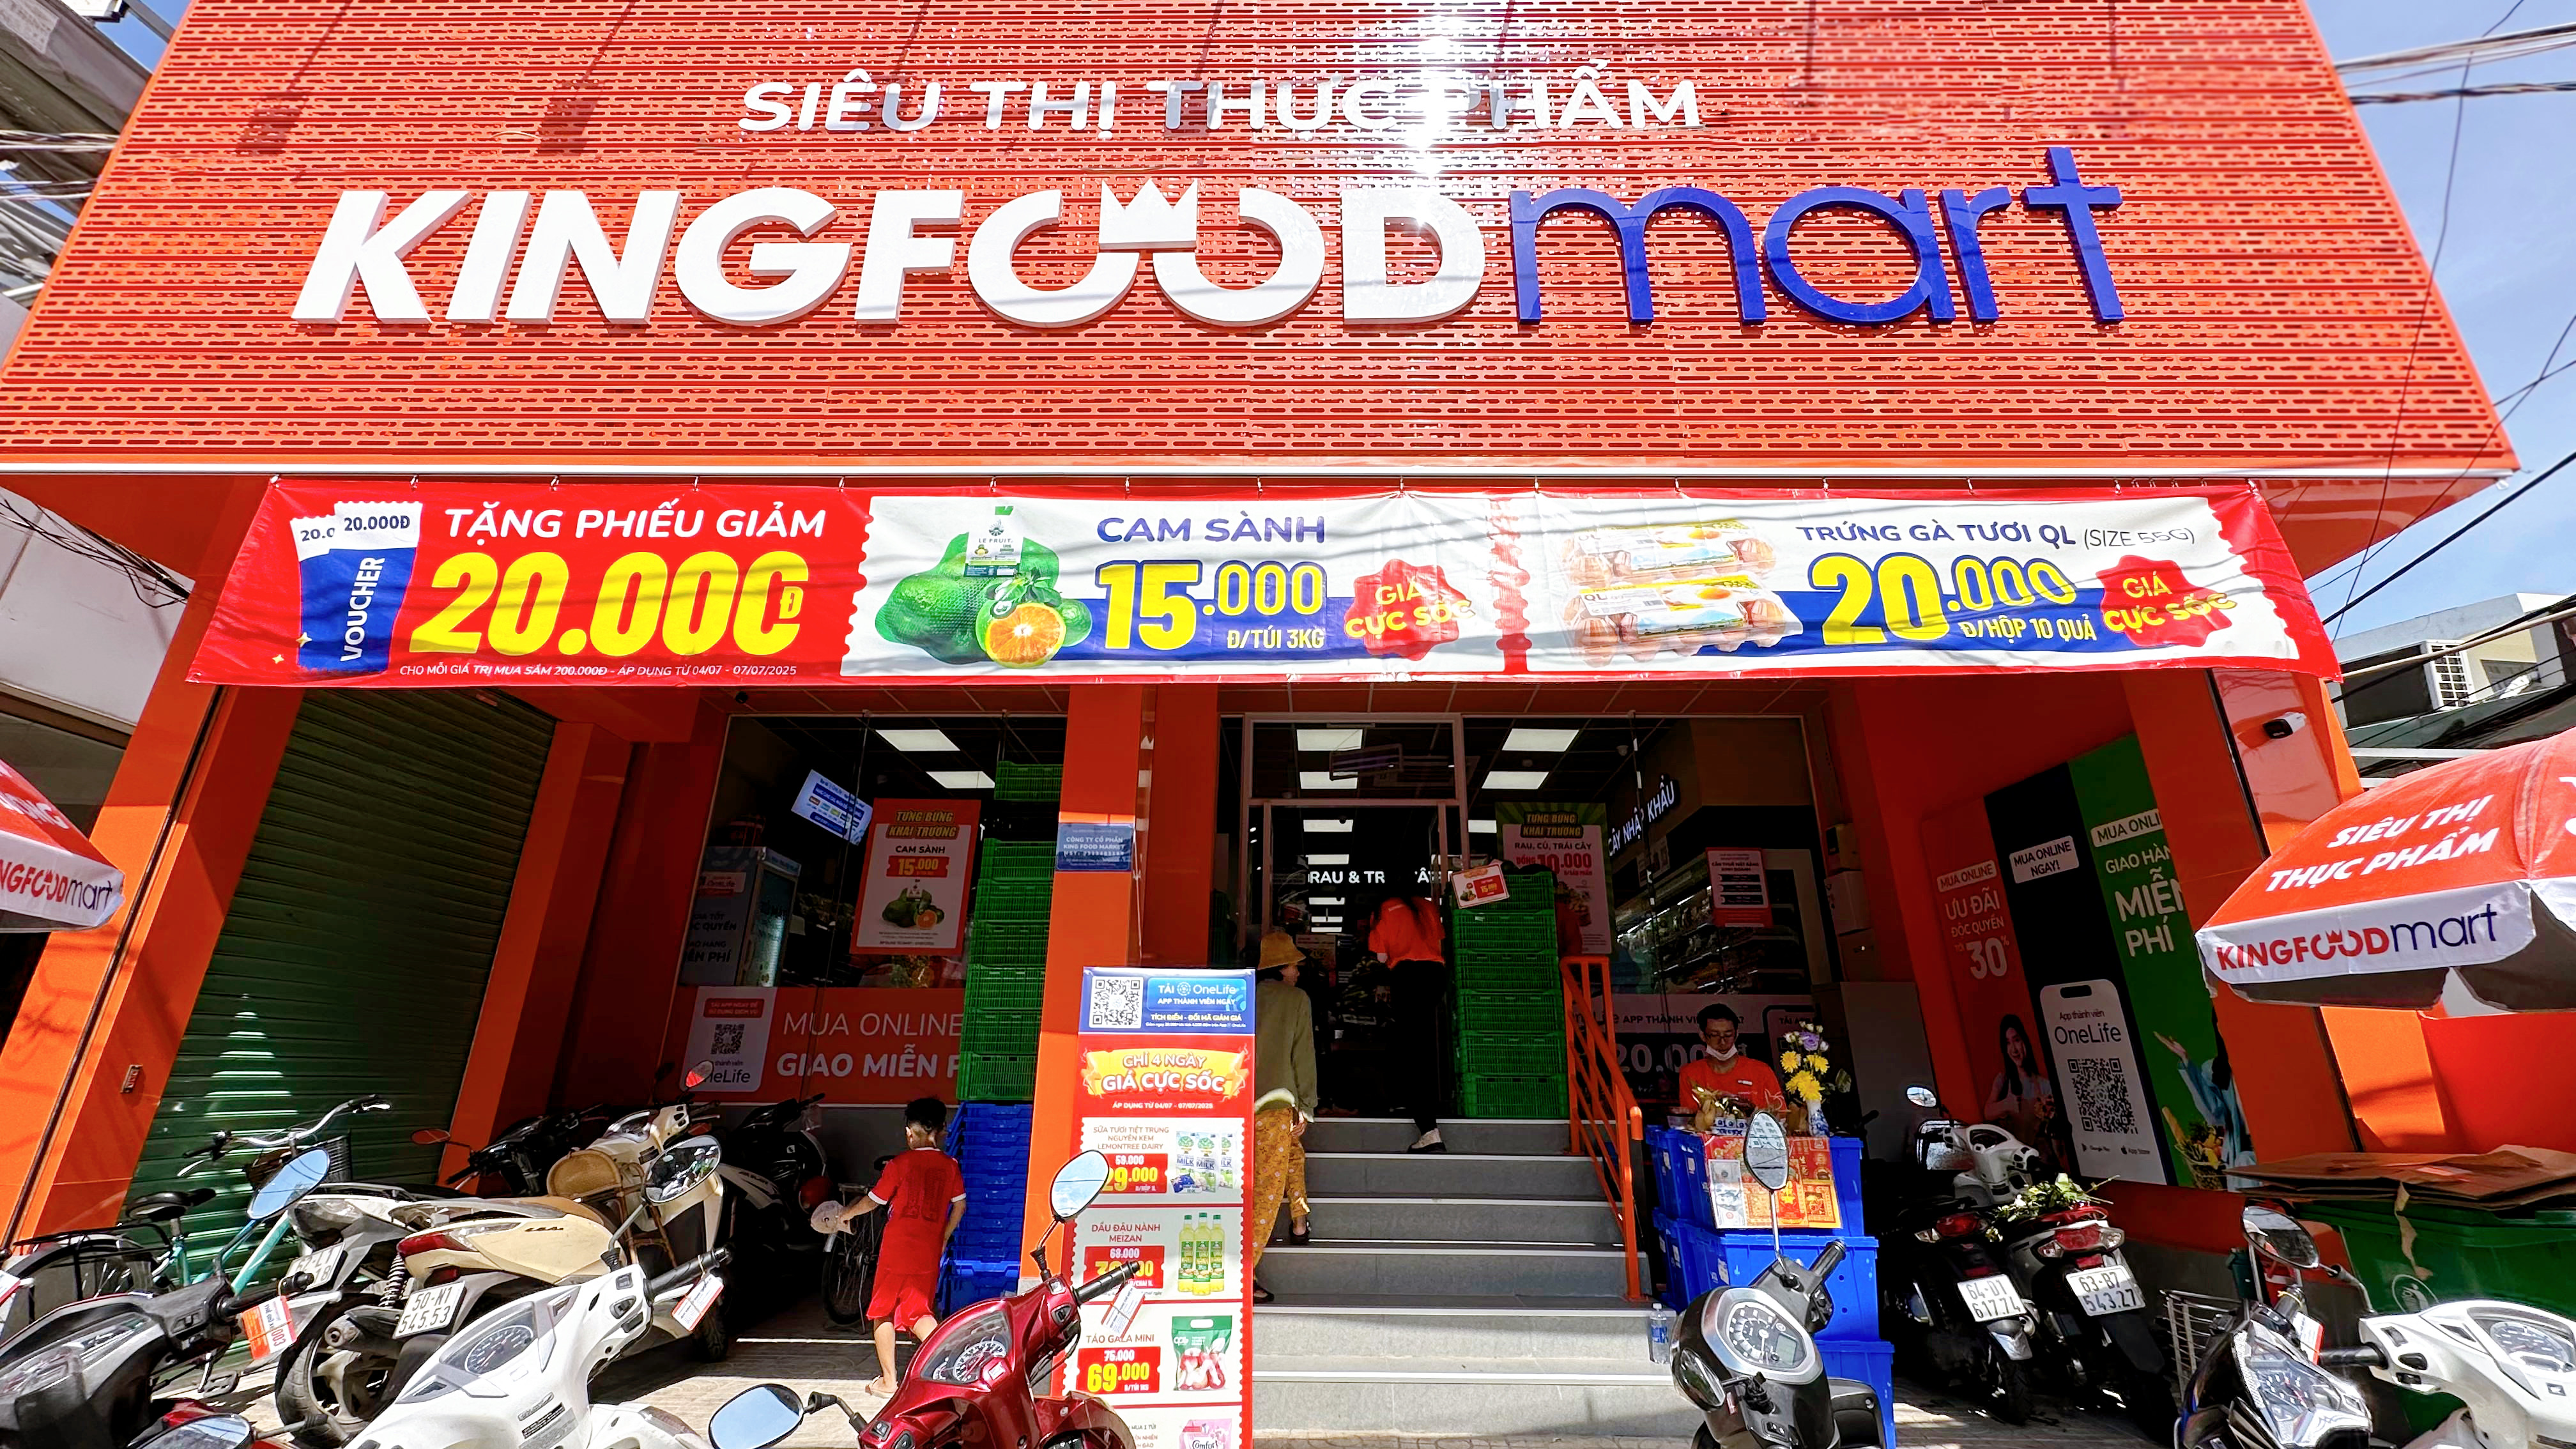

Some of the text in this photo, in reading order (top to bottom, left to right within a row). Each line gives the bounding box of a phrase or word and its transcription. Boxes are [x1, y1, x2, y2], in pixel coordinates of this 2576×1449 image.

[738, 68, 946, 132] SIÊU
[969, 80, 1117, 140] THỊ
[344, 515, 410, 532] 20.000Đ
[445, 497, 826, 546] TẶNG PHIẾU GIẢM
[1097, 510, 1326, 543] CAM SÀNH
[1795, 523, 1901, 542] TRỨNG
[1909, 521, 1955, 542] GÀ
[1956, 524, 2031, 543] TƯƠI
[2038, 525, 2076, 548] QL
[2084, 528, 2133, 550] (SIZE
[2122, 570, 2173, 599] GIÁ
[340, 557, 385, 662] VOUCHER
[1095, 560, 1327, 650] 15.000
[1809, 551, 2079, 645] 20.000
[1345, 609, 1408, 639] CỰC
[2103, 592, 2237, 634] CỰC SỐC
[1227, 623, 1324, 649] Đ/TÚI 3KG
[1958, 614, 2097, 643] Đ/HỘP 10 QUẢ
[399, 665, 424, 675] CHO
[427, 662, 447, 675] MỖI
[450, 663, 470, 675] GIÁ
[473, 664, 492, 677] TRỊ
[494, 666, 521, 675] MUA
[554, 666, 608, 676] 200.000Đ
[675, 664, 691, 676] TỪ
[693, 665, 723, 676] 04/07
[733, 665, 797, 676] 07/07/2025
[2327, 793, 2494, 848] SIÊU THỊ
[2097, 824, 2128, 842] MUA
[919, 844, 946, 854] SÀNH
[2013, 841, 2072, 867] MUA ONLINE
[2266, 822, 2501, 892] THỰC PHẨM
[898, 858, 939, 876] 15.000
[2030, 860, 2060, 877] NGAY!
[2105, 853, 2140, 874] GIAO
[1308, 871, 1360, 884] RAU &
[1940, 864, 1993, 889] MUA ONLINE
[1945, 885, 2000, 921] ƯU ĐÃI
[1972, 912, 2004, 936] QUYỀN
[2124, 915, 2174, 957] PHÍ
[1158, 983, 1237, 994] TẢI OneLife
[783, 1012, 850, 1036] MUA
[2054, 1022, 2122, 1045] OneLife
[777, 1053, 853, 1077] GIAO
[862, 1043, 938, 1078] MIỄN
[1123, 1051, 1207, 1069] CHỈ 4 NGÀY
[1102, 1069, 1225, 1092] GIÁ CỰC SỐC
[1177, 1157, 1194, 1165] MILK
[1196, 1160, 1215, 1169] MILK
[1091, 1221, 1160, 1234] DẦU ĐẬU NÀNH
[1109, 1234, 1142, 1243] MEIZAN
[1965, 1279, 2007, 1300] 64-D1
[2078, 1272, 2120, 1294] 63-B7
[412, 1286, 453, 1311] 50-N1
[1972, 1299, 2021, 1319] 617.74
[2083, 1289, 2138, 1312] 543.27
[399, 1305, 451, 1334] 545.53
[271, 1328, 286, 1347] 003
[1086, 1333, 1154, 1343] TÁO GALA MINI
[1087, 1362, 1149, 1393] 69.000
[1192, 1439, 1219, 1449] Comfort
